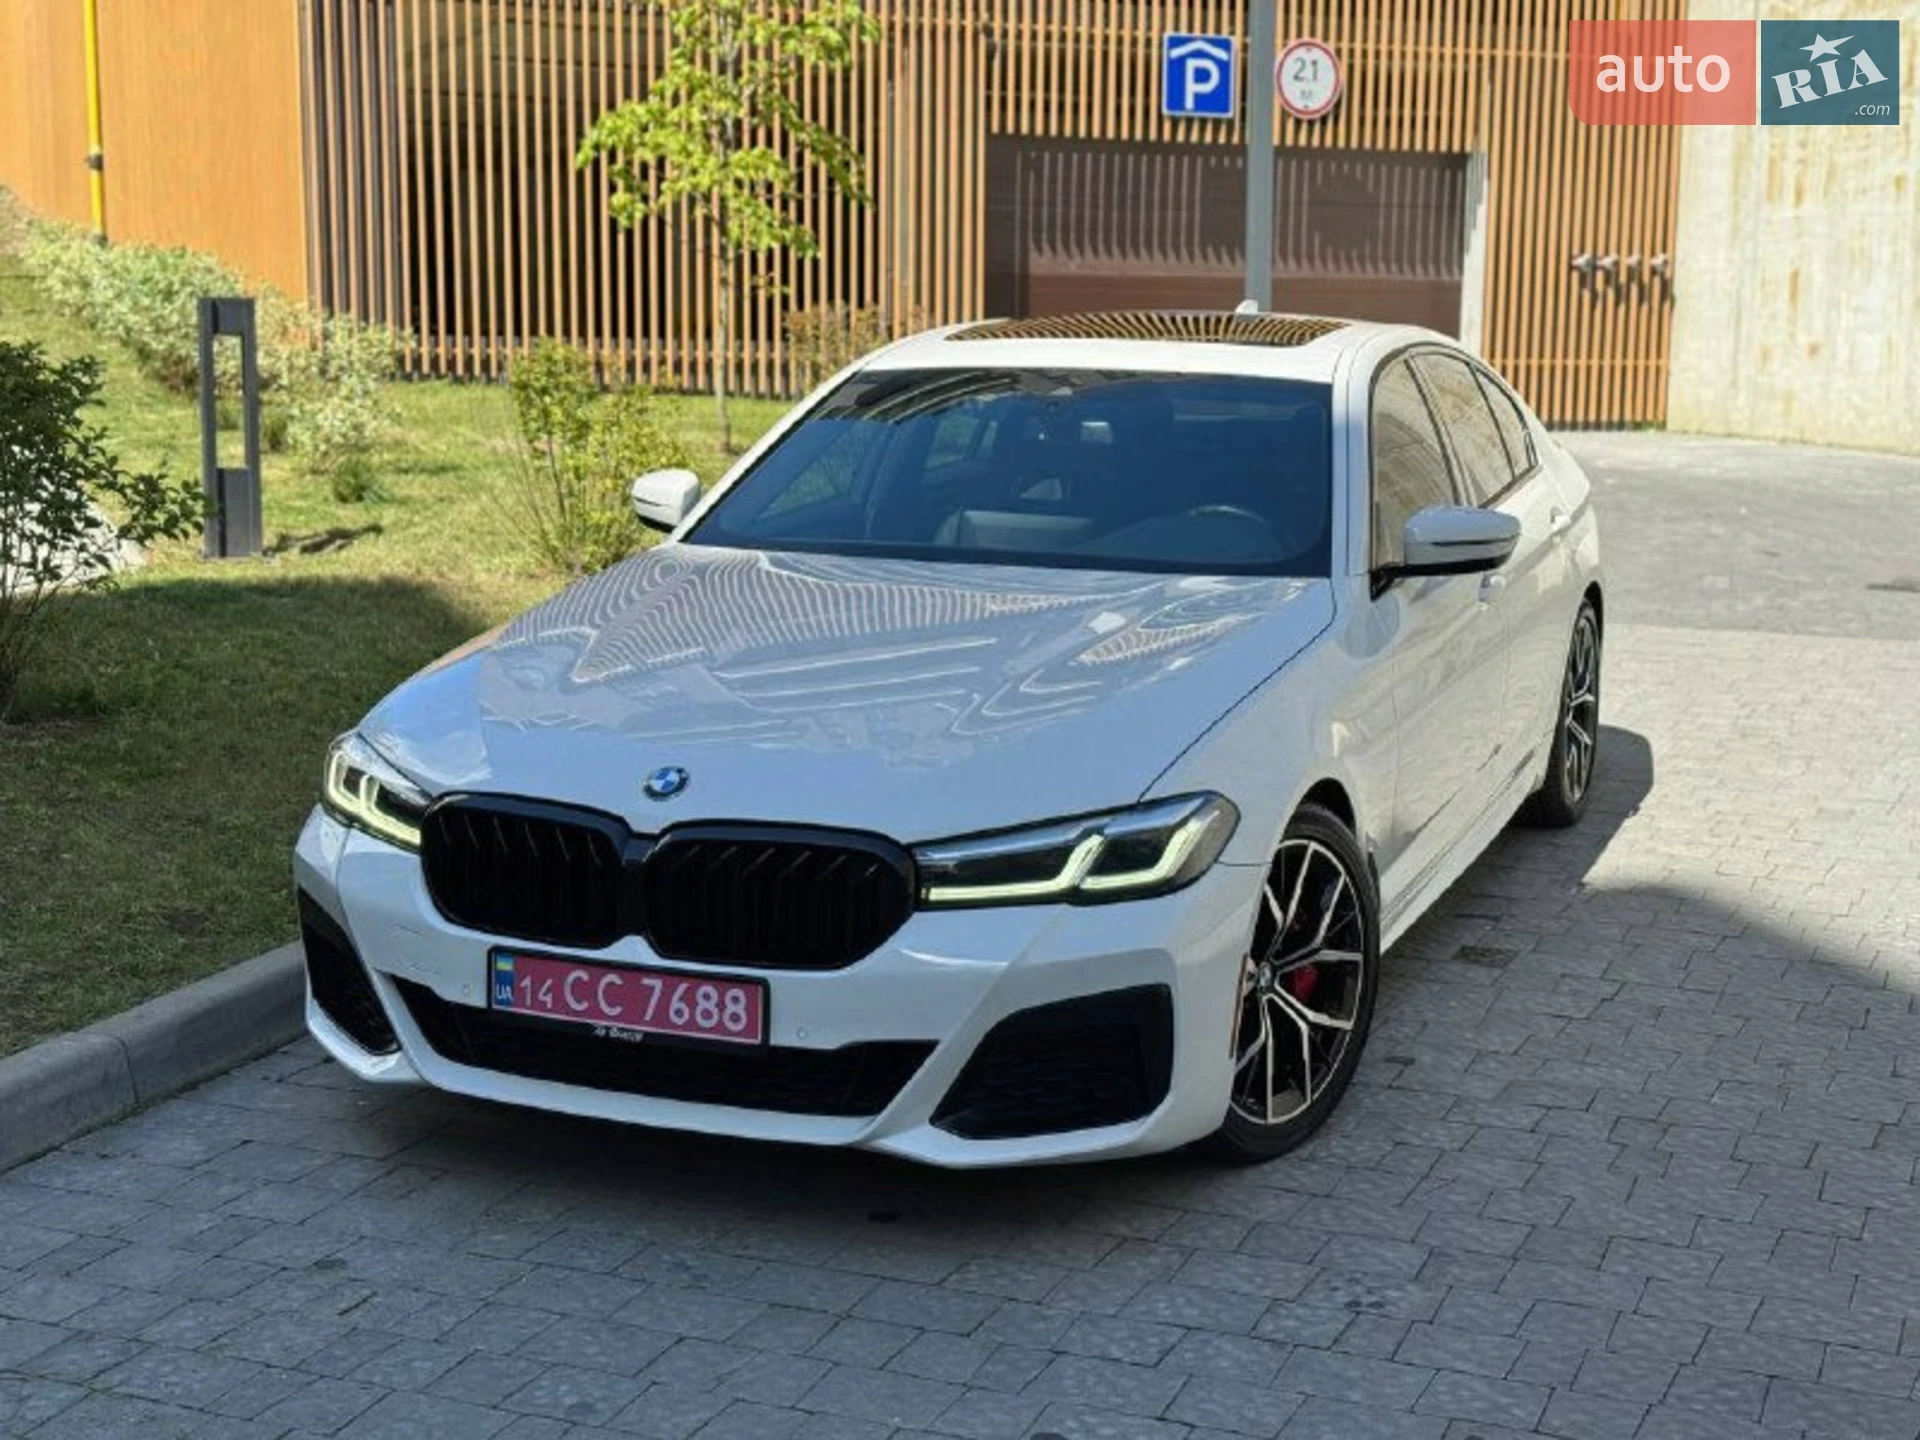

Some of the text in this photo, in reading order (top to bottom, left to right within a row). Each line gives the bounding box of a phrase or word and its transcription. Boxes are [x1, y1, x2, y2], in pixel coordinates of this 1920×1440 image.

[1185, 58, 1220, 110] P
[496, 984, 514, 1002] UA
[641, 978, 748, 1032] 7688
